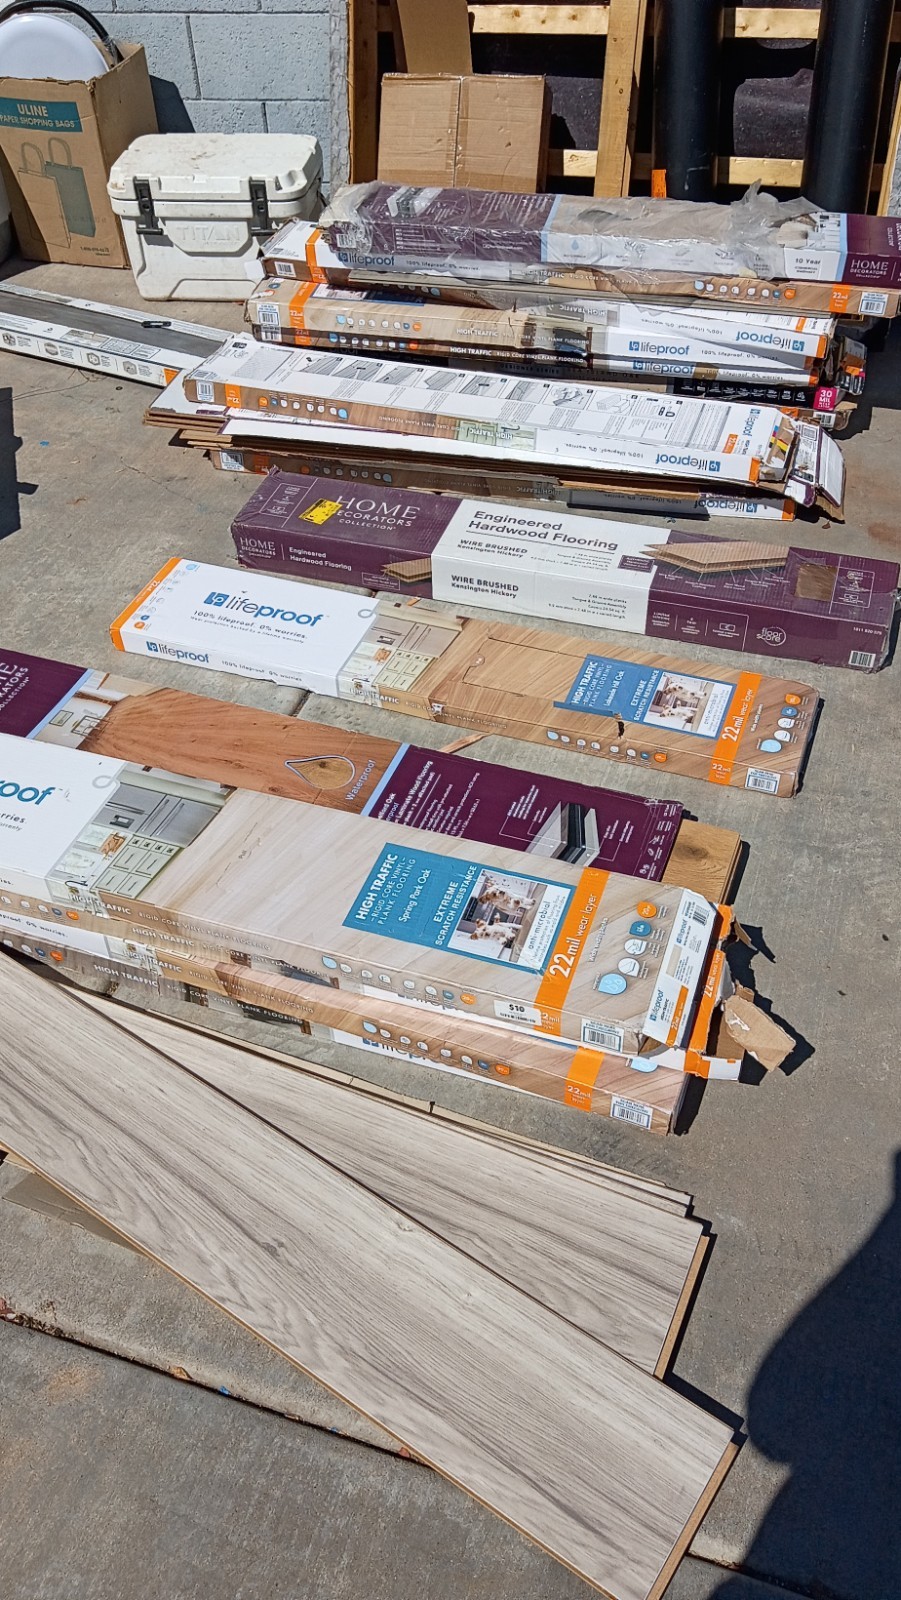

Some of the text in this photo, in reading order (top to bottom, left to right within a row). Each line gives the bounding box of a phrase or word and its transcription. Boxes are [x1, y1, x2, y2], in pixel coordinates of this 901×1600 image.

[17, 104, 48, 117] ULINE
[20, 117, 54, 127] SHOPPING
[55, 120, 75, 128] BAGS
[176, 225, 240, 241] TITAN
[350, 252, 395, 266] lifeproof
[851, 259, 889, 270] HOME
[456, 328, 473, 336] HIGH
[474, 329, 498, 337] TRAFFIC
[735, 331, 792, 350] lifeproof
[468, 348, 492, 356] TRAFFIC
[640, 341, 690, 356] lifeproof
[645, 360, 694, 374] lifeproof
[820, 389, 832, 397] 30
[655, 453, 708, 470] lifeproof
[335, 496, 420, 519] HOME
[336, 510, 412, 527] ECORATORS
[339, 518, 394, 531] COLLECTION
[474, 510, 563, 531] Engineered
[240, 537, 275, 550] HOME
[468, 521, 619, 551] Hardwood Flooring
[289, 546, 327, 558] Engineered
[457, 544, 523, 558] Kensington Hickory
[460, 539, 528, 554] WIRE BRUSHED
[290, 555, 352, 571] Hardwood Flooring
[451, 574, 519, 592] WIRE BRUSHED
[451, 582, 517, 599] Kensington Hickory
[193, 610, 215, 621] 100%
[225, 596, 324, 627] lifeproof
[756, 634, 781, 643] score
[761, 627, 782, 637] floor
[158, 643, 210, 664] lifeproof
[0, 667, 29, 698] RATORS
[571, 661, 599, 704] HIGH TRAFFIC
[615, 670, 625, 682] Oak
[0, 677, 29, 710] OLLECTION
[630, 679, 645, 707] EXTREME
[633, 669, 660, 721] SCRATCH RESISTANCE
[740, 701, 750, 717] wear
[745, 688, 754, 703] layer
[345, 759, 377, 801] Waterproof
[355, 853, 398, 920] HIGH TRAFFIC
[378, 858, 416, 925] PLANK FLOORING
[382, 881, 394, 899] CORE
[398, 869, 432, 923] Spring Park Oak
[433, 881, 459, 923] EXTREME
[97, 901, 131, 915] TRAFFIC
[161, 917, 180, 926] CORE
[435, 910, 455, 946] SCRATCH
[451, 865, 478, 911] RESISTANCE
[576, 913, 590, 938] wear
[585, 893, 598, 915] layer
[528, 901, 551, 950] anti-microbial
[132, 927, 157, 938] HIGH
[158, 933, 195, 946] TRAFFIC
[149, 957, 182, 973] TRAFFIC
[94, 965, 118, 977] HIGH
[121, 971, 158, 987] TRAFFIC
[238, 1001, 261, 1014] PLANK
[263, 1009, 303, 1024] FLOORING
